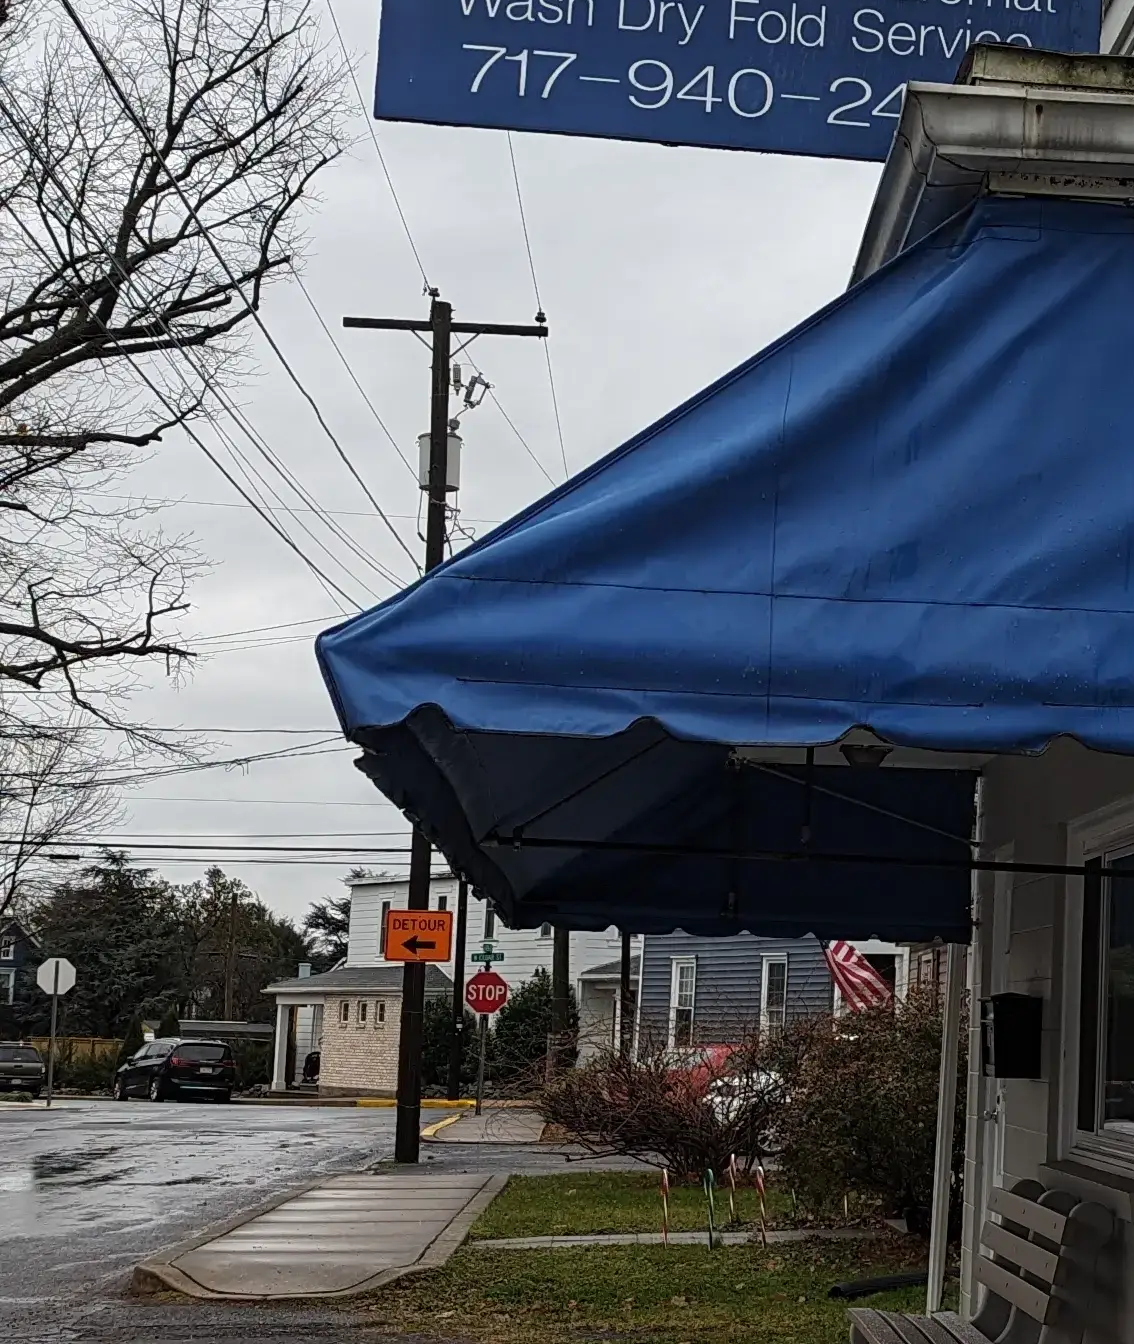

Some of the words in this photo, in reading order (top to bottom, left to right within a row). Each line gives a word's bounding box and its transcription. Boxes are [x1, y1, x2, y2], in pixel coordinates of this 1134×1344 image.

[461, 43, 907, 129] 717-940-24
[392, 918, 446, 932] DETOUR
[467, 984, 506, 1002] STOP
